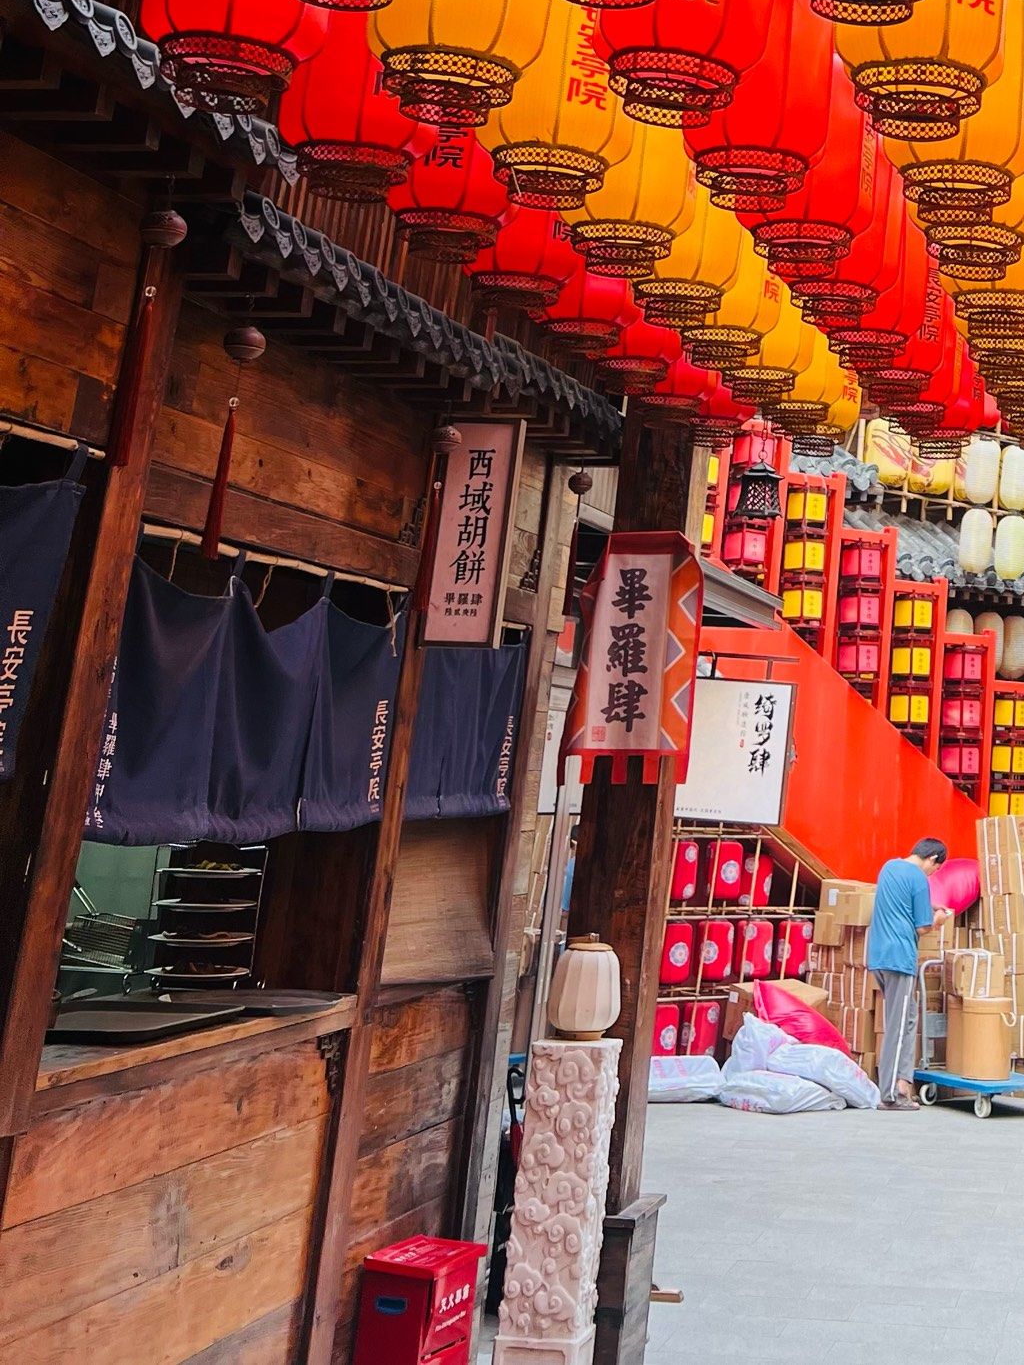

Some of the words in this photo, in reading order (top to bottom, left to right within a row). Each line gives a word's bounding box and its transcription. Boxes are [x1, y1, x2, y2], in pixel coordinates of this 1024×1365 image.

[450, 449, 497, 586] 西域胡餅
[601, 568, 653, 733] 畢羅肆
[368, 700, 389, 803] 長安亭院
